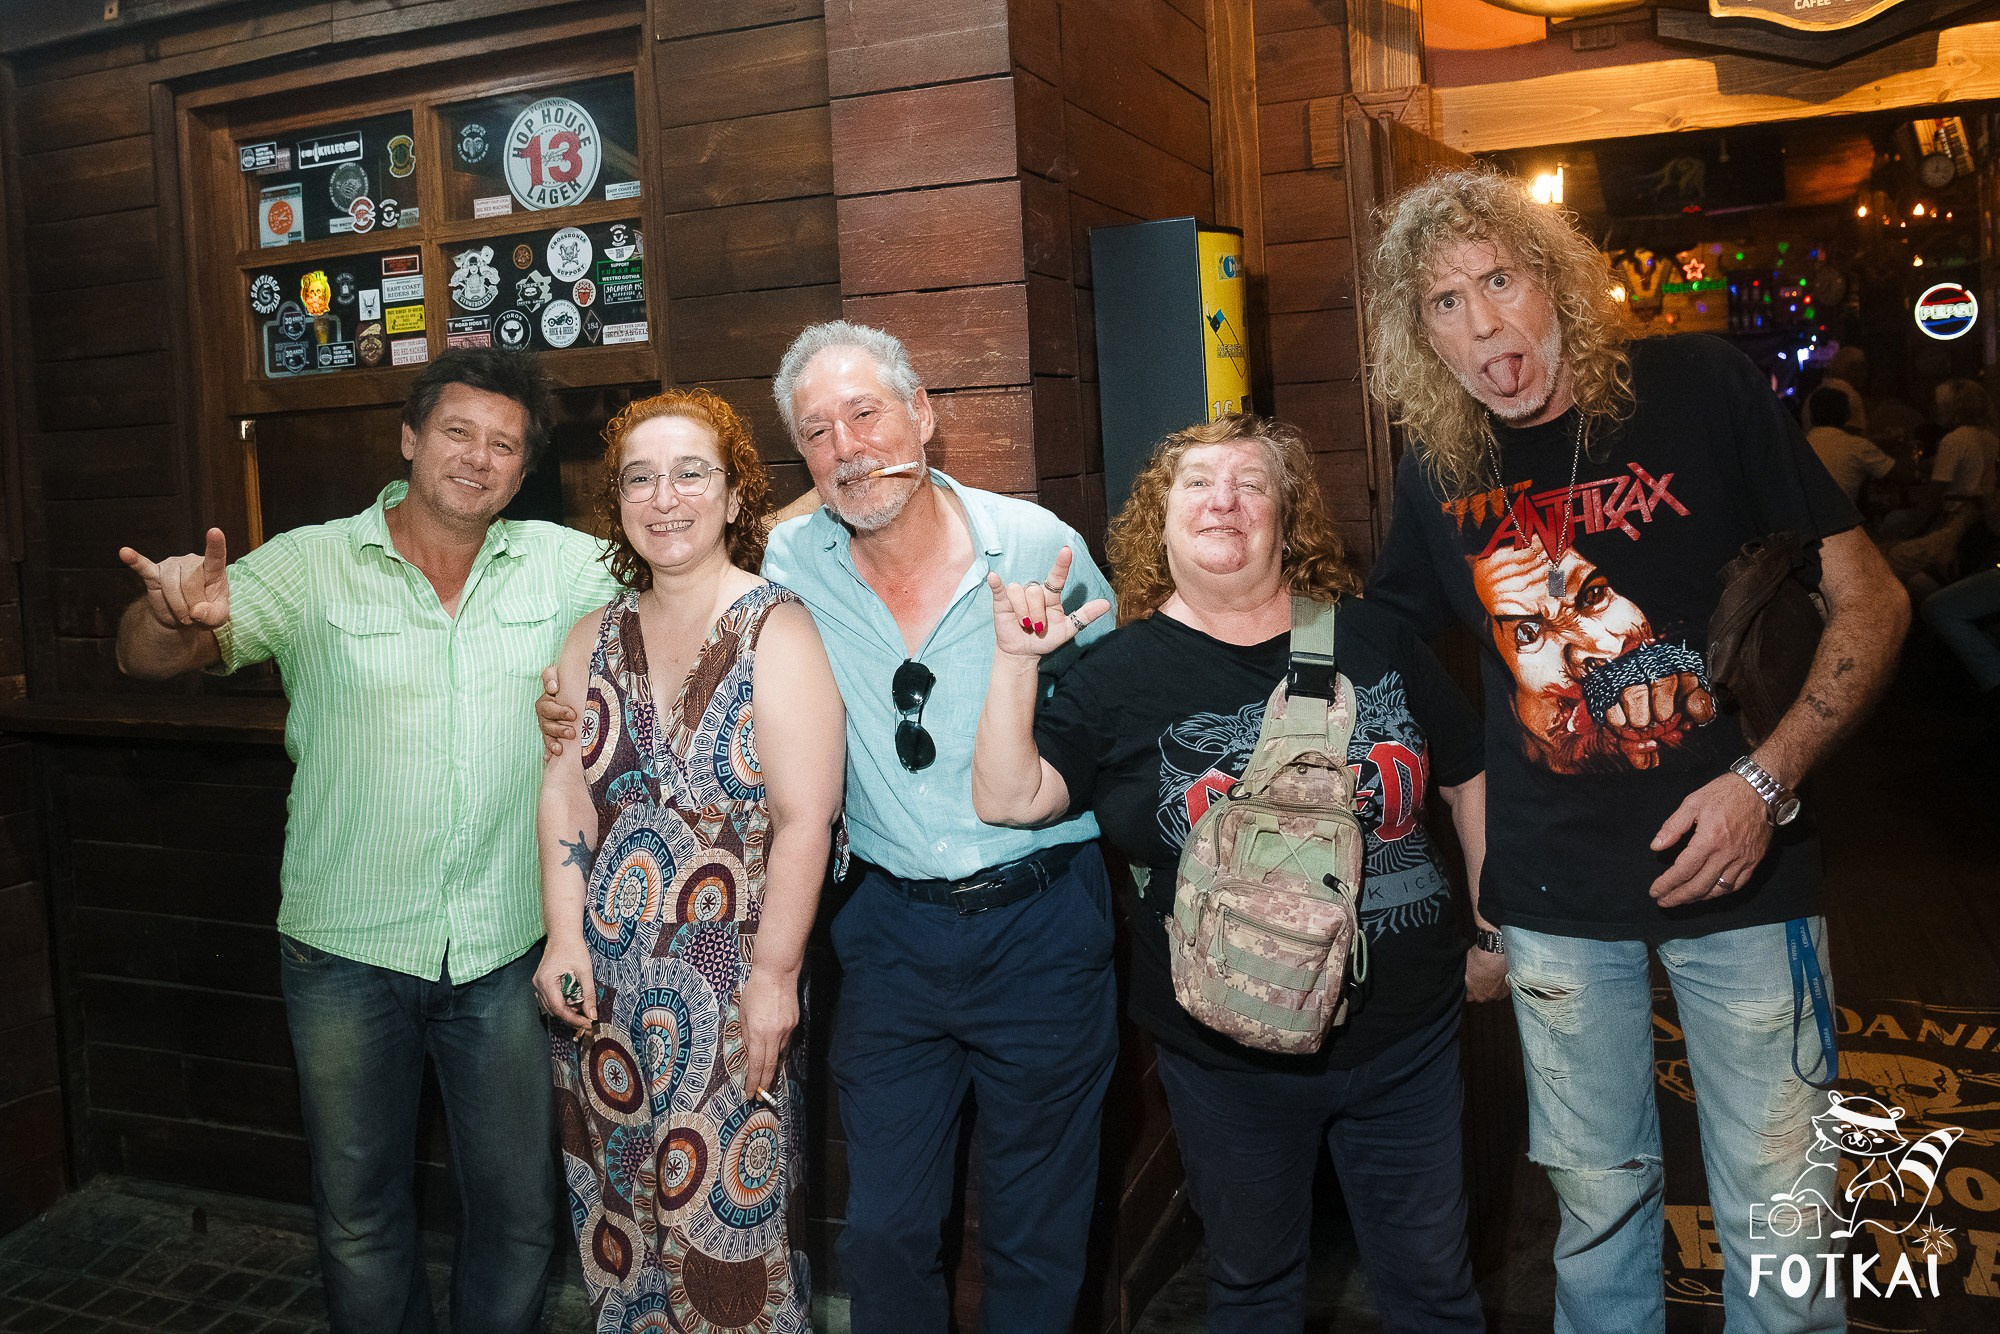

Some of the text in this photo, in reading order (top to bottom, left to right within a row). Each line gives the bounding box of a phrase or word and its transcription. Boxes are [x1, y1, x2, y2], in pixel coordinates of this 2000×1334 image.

[512, 118, 534, 159] HOP
[541, 107, 592, 148] HOUSE
[521, 131, 583, 186] 13
[527, 181, 582, 205] LAGER
[557, 264, 585, 276] SUPPORT
[1920, 303, 1974, 320] PEPSI
[1477, 462, 1692, 567] ANTHRAX
[1403, 870, 1437, 893] ICE
